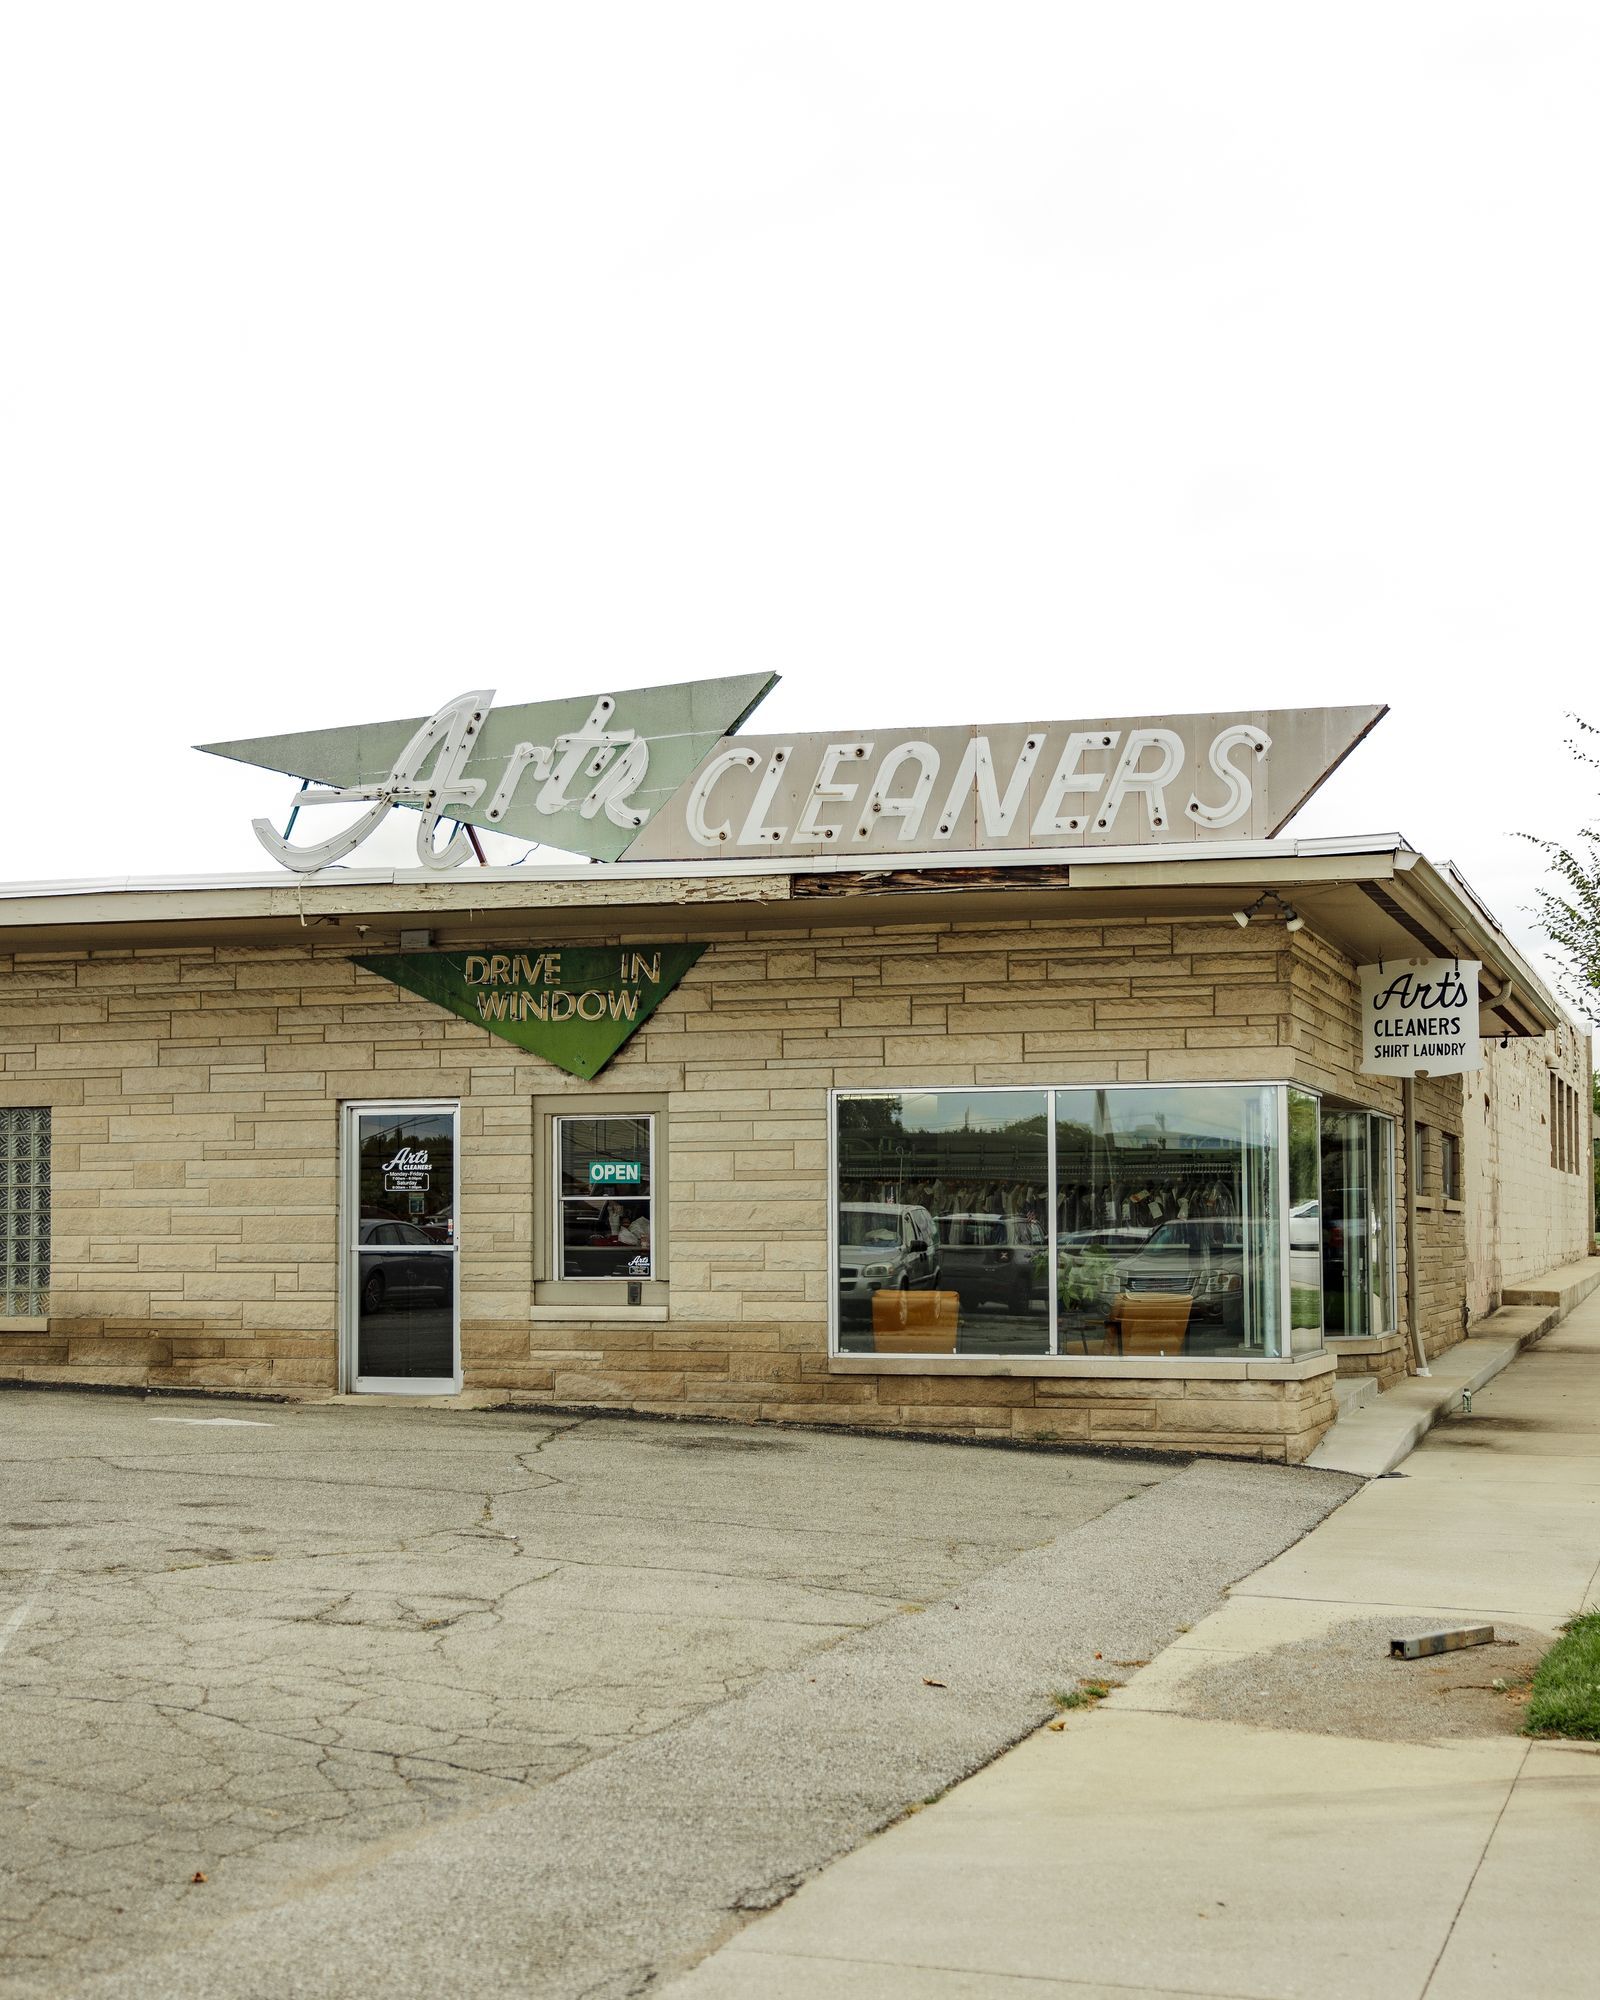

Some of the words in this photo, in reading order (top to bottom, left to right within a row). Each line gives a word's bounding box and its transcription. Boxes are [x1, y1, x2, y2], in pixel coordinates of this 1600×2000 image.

[685, 725, 1272, 847] CLEANERS
[465, 954, 561, 985] DRIVE
[621, 952, 661, 984] IN
[1373, 971, 1468, 1011] Art's
[477, 990, 641, 1022] WINDOW
[1374, 1017, 1461, 1037] CLEANERS
[1374, 1044, 1409, 1059] SHIRT
[1413, 1043, 1466, 1057] LAUNDRY
[382, 1147, 428, 1171] Art's
[591, 1164, 638, 1181] OPEN
